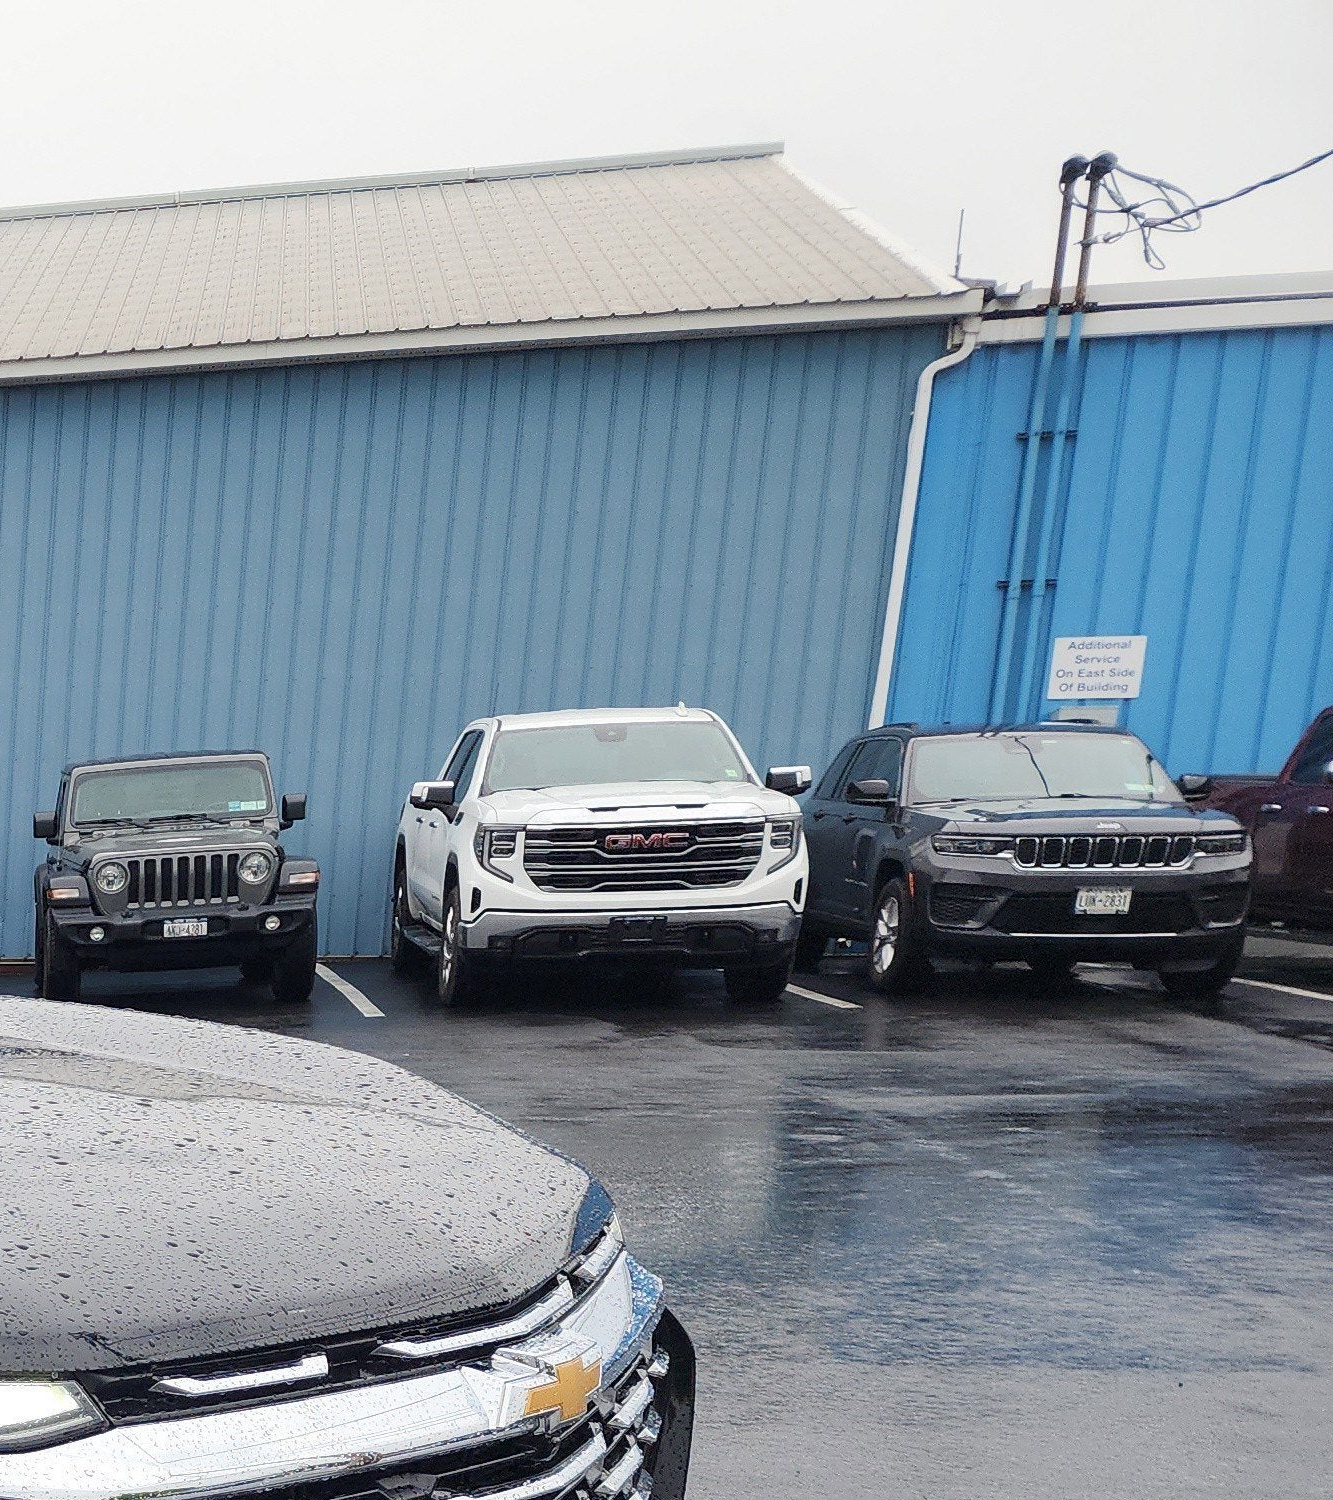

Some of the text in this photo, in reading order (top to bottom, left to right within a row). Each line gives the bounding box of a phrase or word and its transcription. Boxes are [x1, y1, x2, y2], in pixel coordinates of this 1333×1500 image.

[1067, 640, 1132, 650] Additional
[1074, 654, 1121, 664] Service
[1056, 668, 1135, 678] On East Side
[1059, 682, 1128, 693] Of Building
[604, 832, 690, 850] GMC
